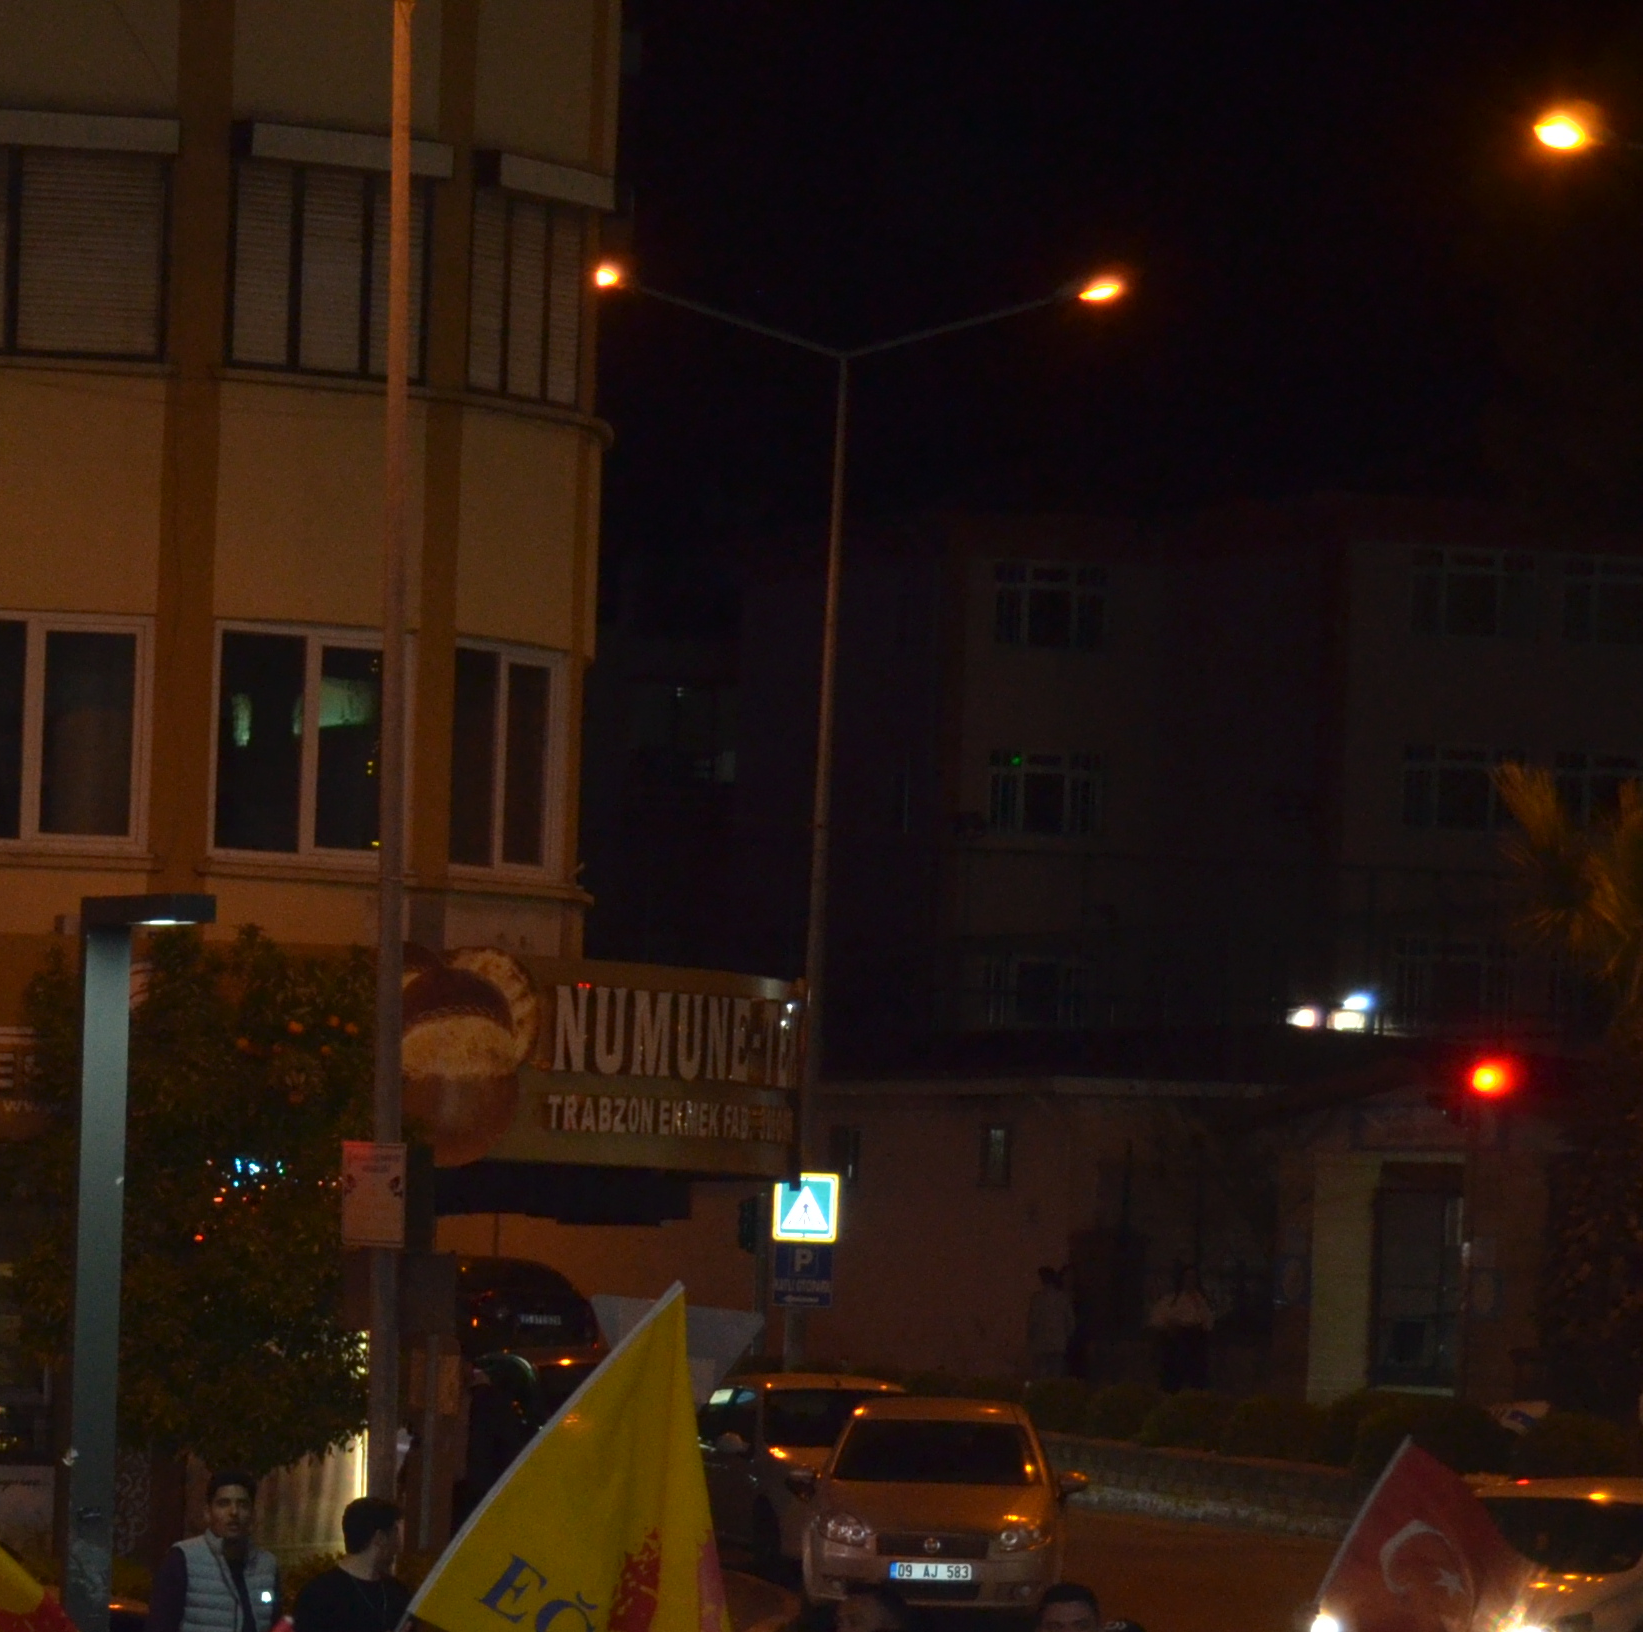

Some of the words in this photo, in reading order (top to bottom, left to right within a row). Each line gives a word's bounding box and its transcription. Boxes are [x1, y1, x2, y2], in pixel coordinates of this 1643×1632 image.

[547, 1094, 654, 1134] TRABZON
[898, 1564, 913, 1577] 09
[923, 1565, 938, 1578] AJ
[946, 1566, 969, 1579] 583
